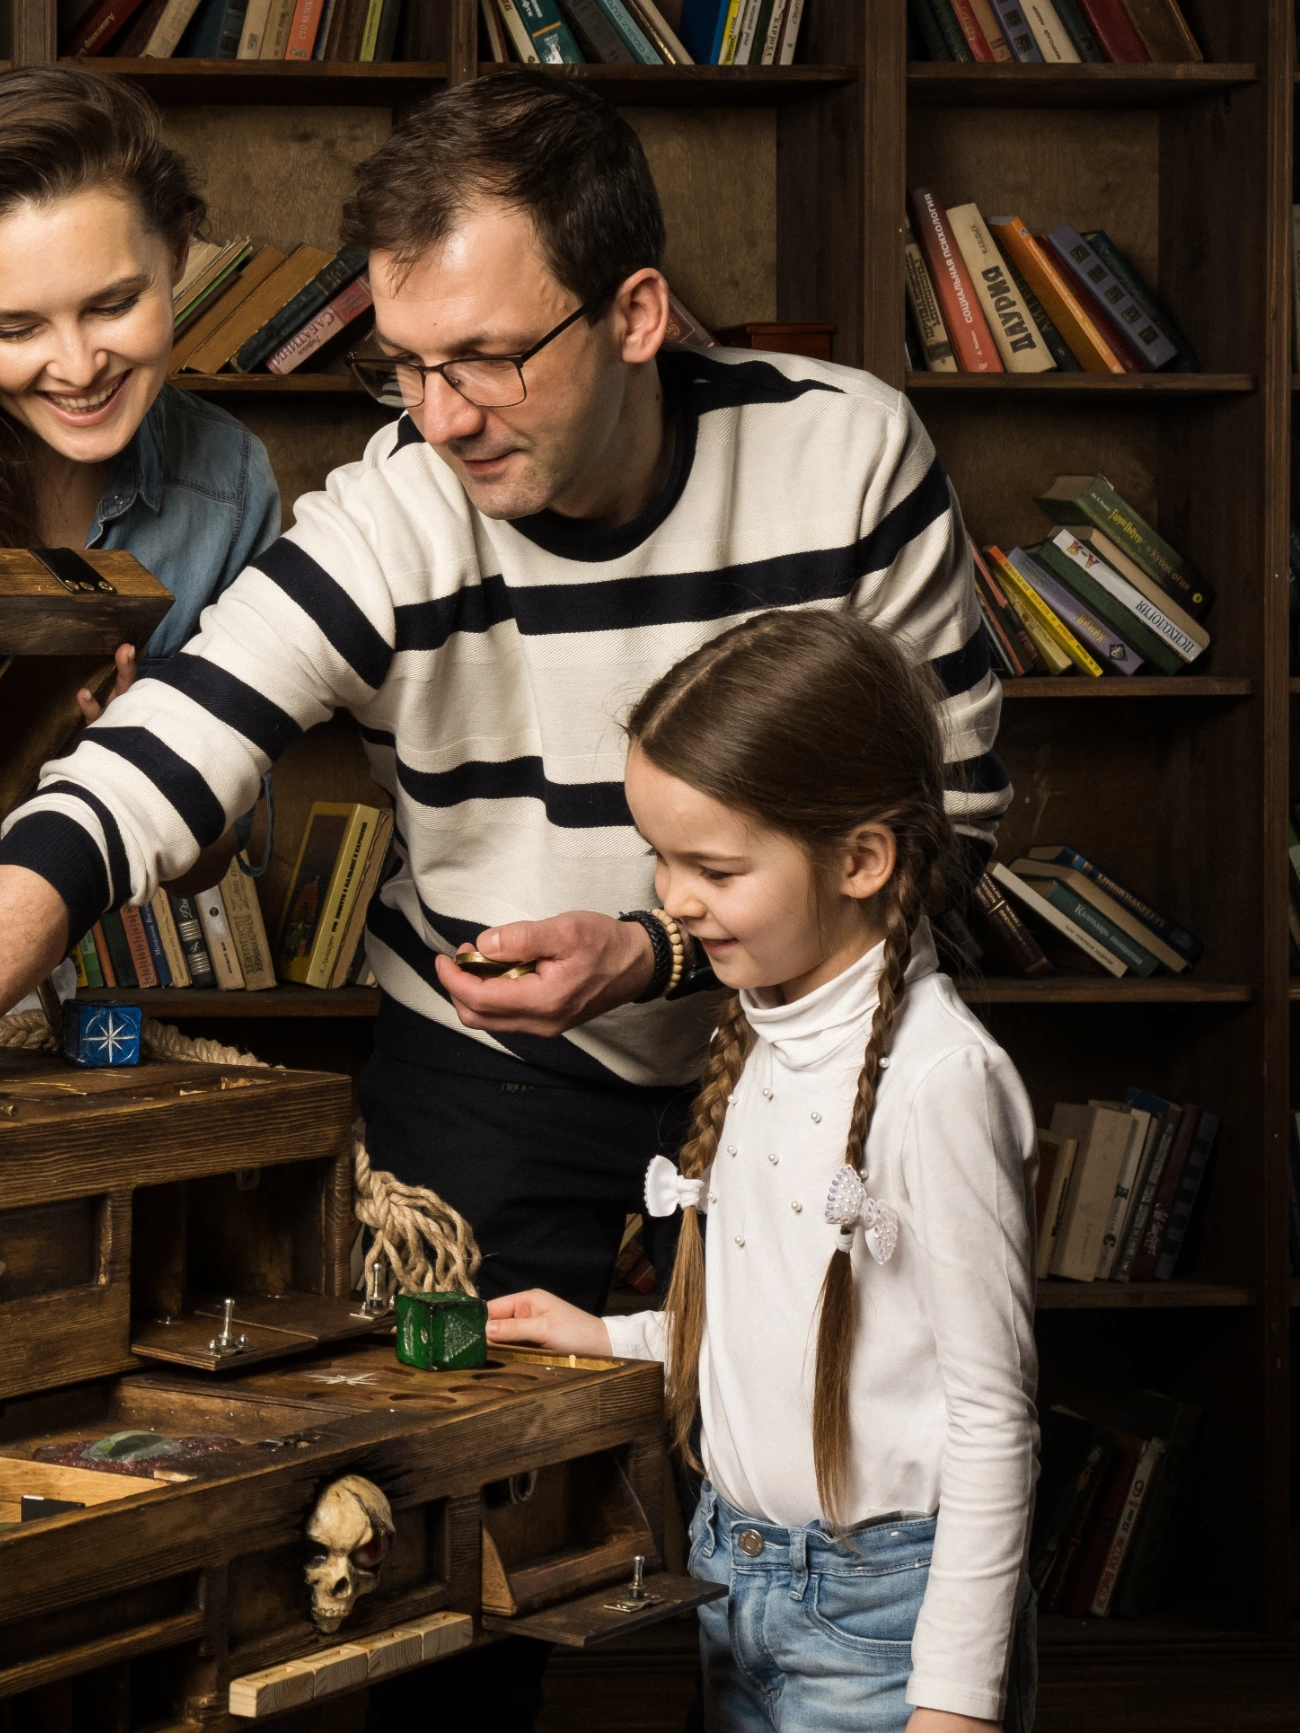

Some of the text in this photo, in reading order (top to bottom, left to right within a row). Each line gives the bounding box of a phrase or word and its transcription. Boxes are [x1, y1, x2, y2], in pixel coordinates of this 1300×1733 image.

[81, 11, 116, 48] Александр
[923, 192, 974, 324] СОЦИАЛЬНАЯ ПСИХОЛОГИЯ
[978, 262, 1037, 356] ДАУРИЯ
[270, 309, 336, 366] САБАТИНИ
[1064, 539, 1100, 572] А-Я
[1133, 599, 1195, 654] ПСИХОЛОГИЯ
[1073, 903, 1111, 939] Календарь
